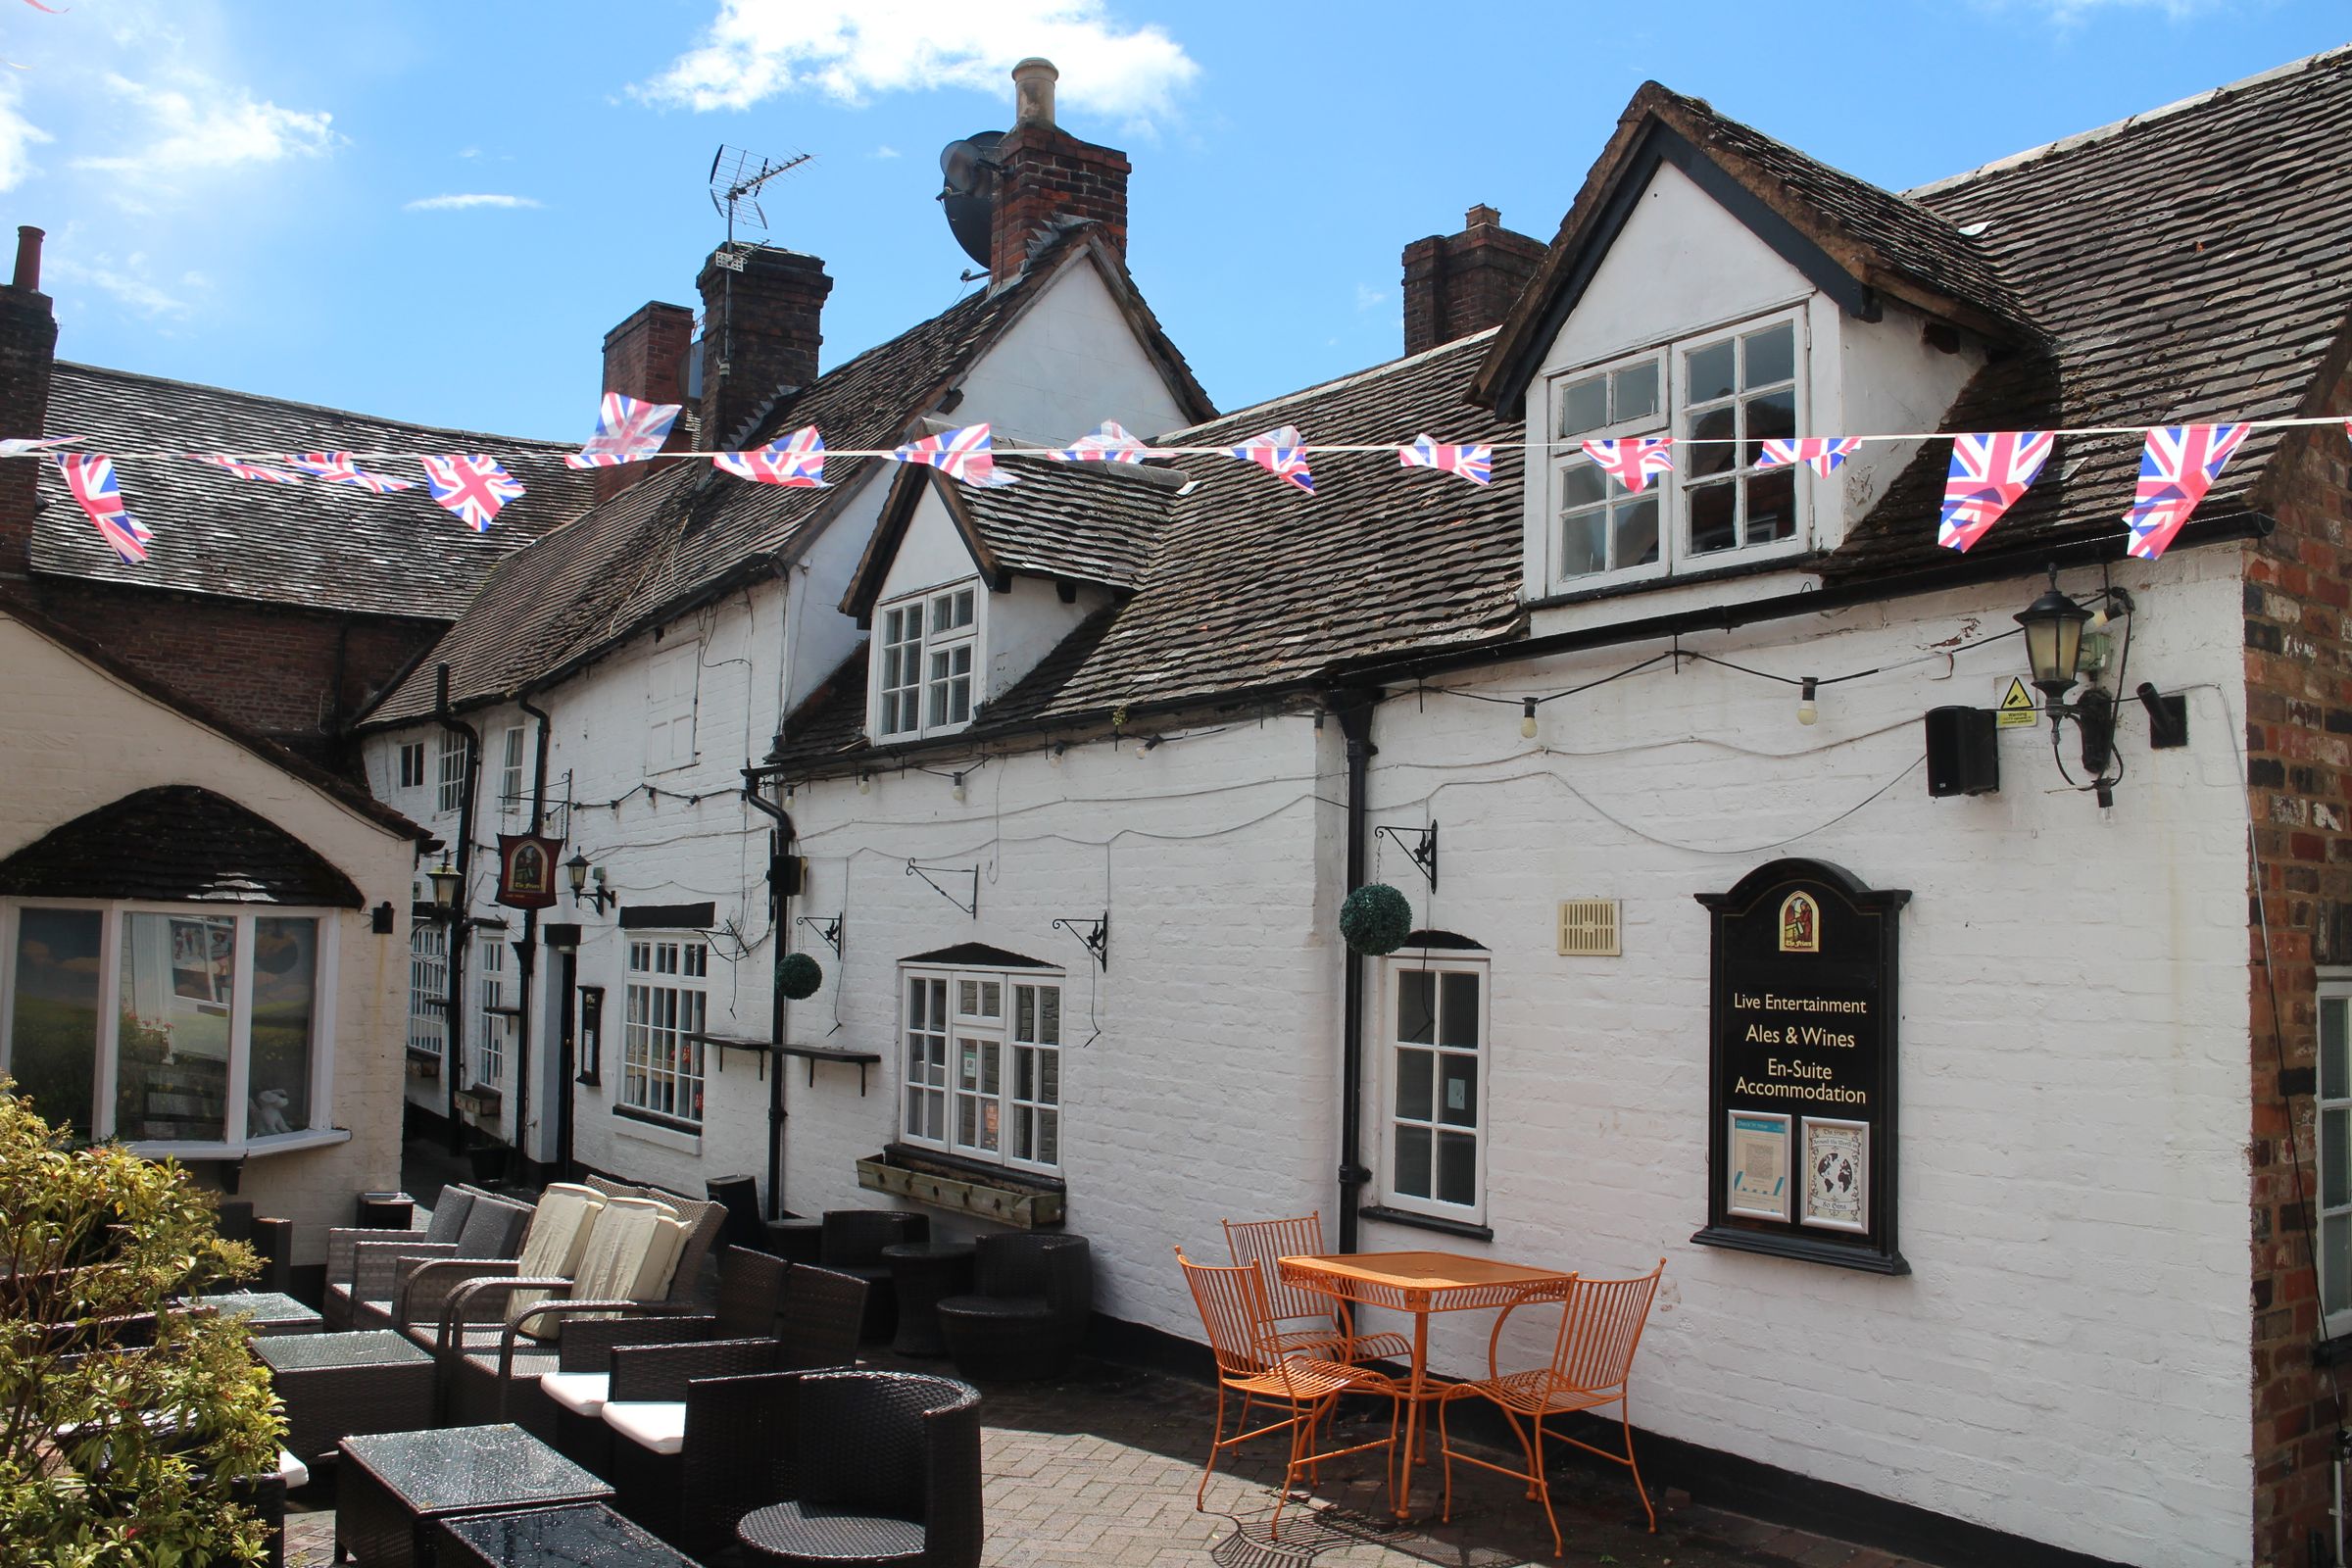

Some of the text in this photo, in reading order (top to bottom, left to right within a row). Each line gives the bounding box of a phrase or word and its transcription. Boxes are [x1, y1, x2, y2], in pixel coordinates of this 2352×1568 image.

[1734, 993, 1867, 1013] Live Entertainment
[1745, 1024, 1855, 1048] Ales & Wines
[1768, 1058, 1833, 1080] En-Suite
[1735, 1076, 1867, 1104] Accommodation
